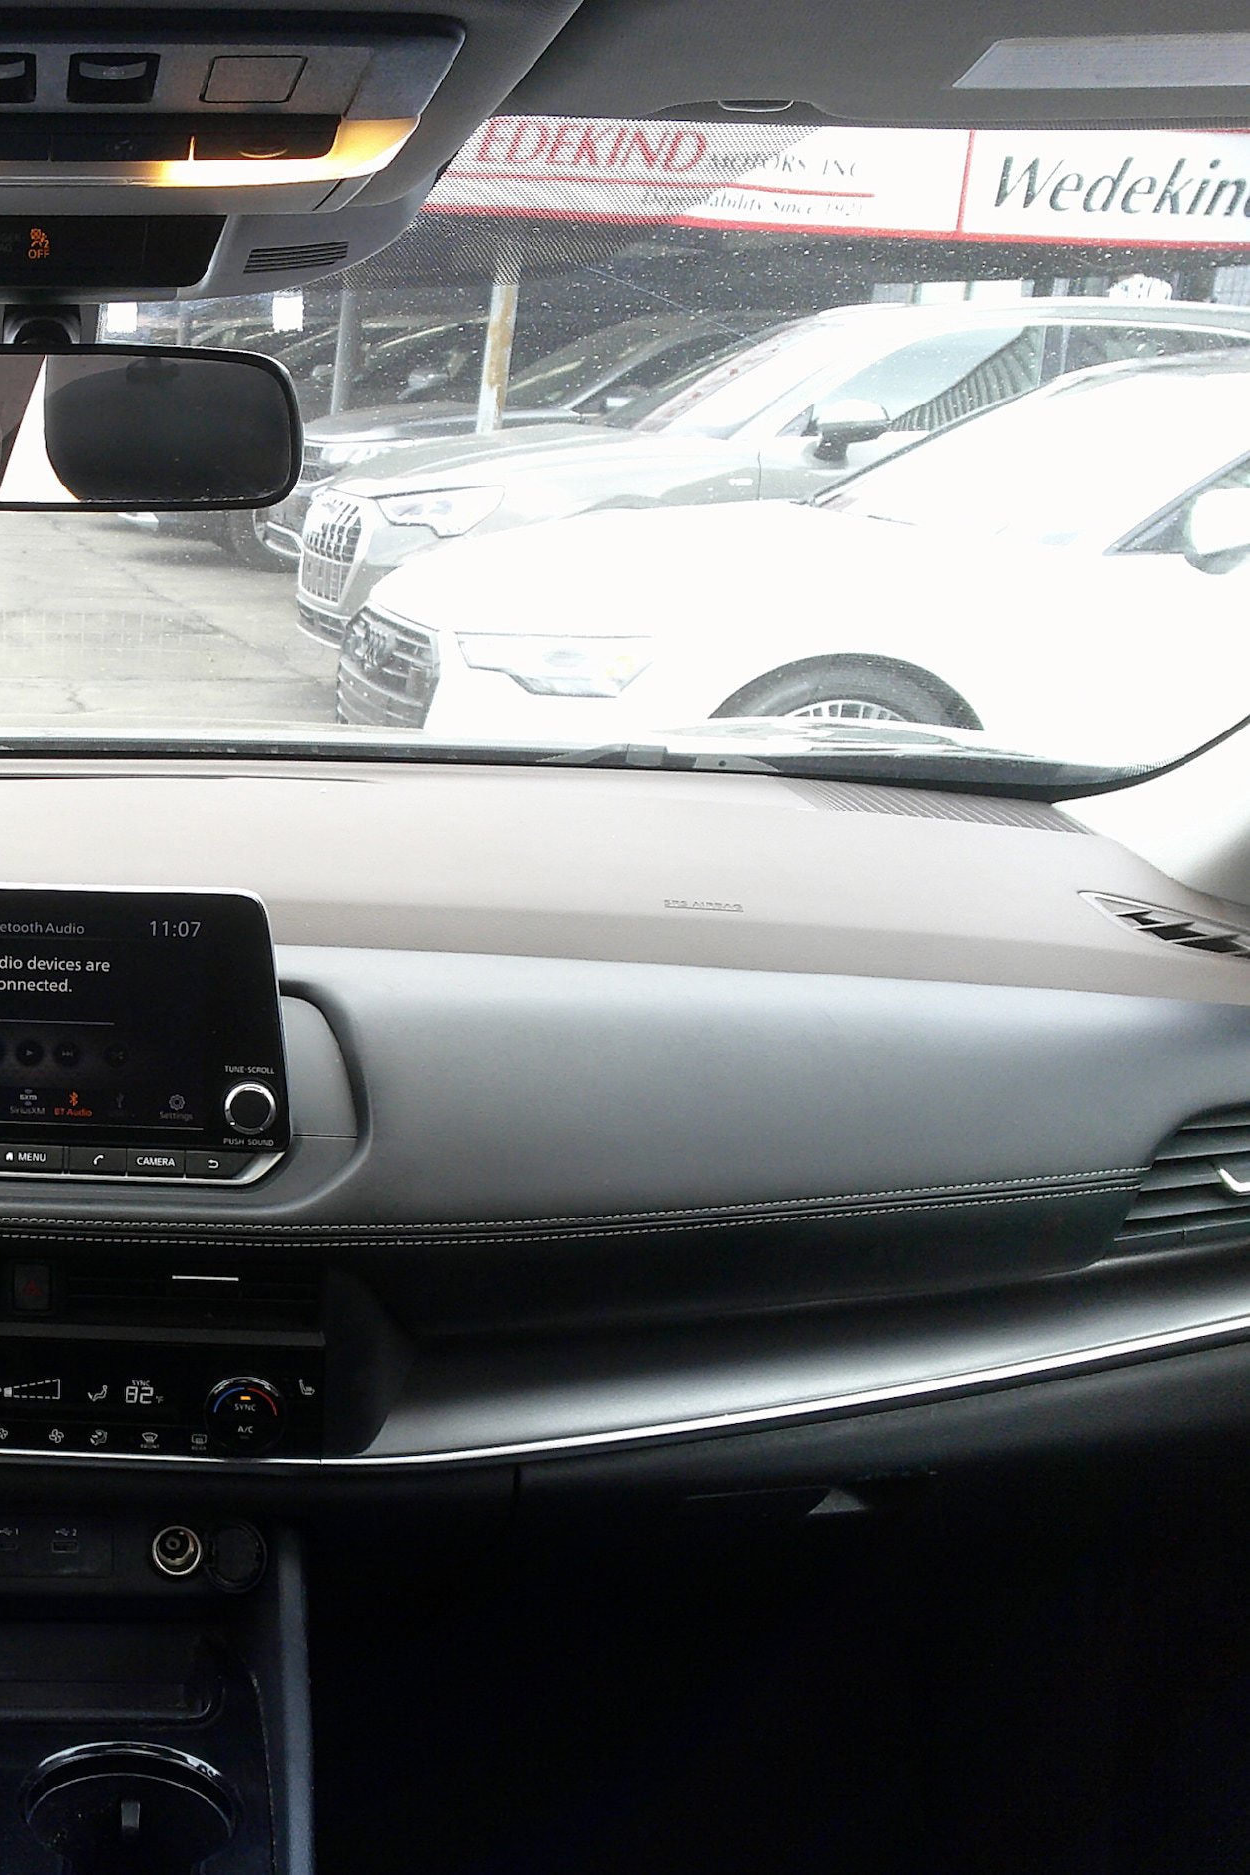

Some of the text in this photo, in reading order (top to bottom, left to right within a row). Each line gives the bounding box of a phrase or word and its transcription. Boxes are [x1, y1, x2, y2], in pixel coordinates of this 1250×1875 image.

[473, 119, 708, 173] EDEKIND
[27, 248, 51, 261] OFF
[45, 921, 85, 935] Audio
[148, 920, 202, 938] 11:07
[27, 956, 81, 972] devices
[85, 958, 111, 972] are
[8, 1105, 47, 1115] SiriusXM
[53, 1107, 94, 1118] BT Audio
[158, 1111, 194, 1122] Settings
[222, 1138, 275, 1147] PUSH SOUND
[17, 1151, 47, 1163] MENU
[136, 1156, 176, 1167] CAMERA
[234, 1403, 257, 1412] SYNC
[237, 1425, 254, 1434] A/C
